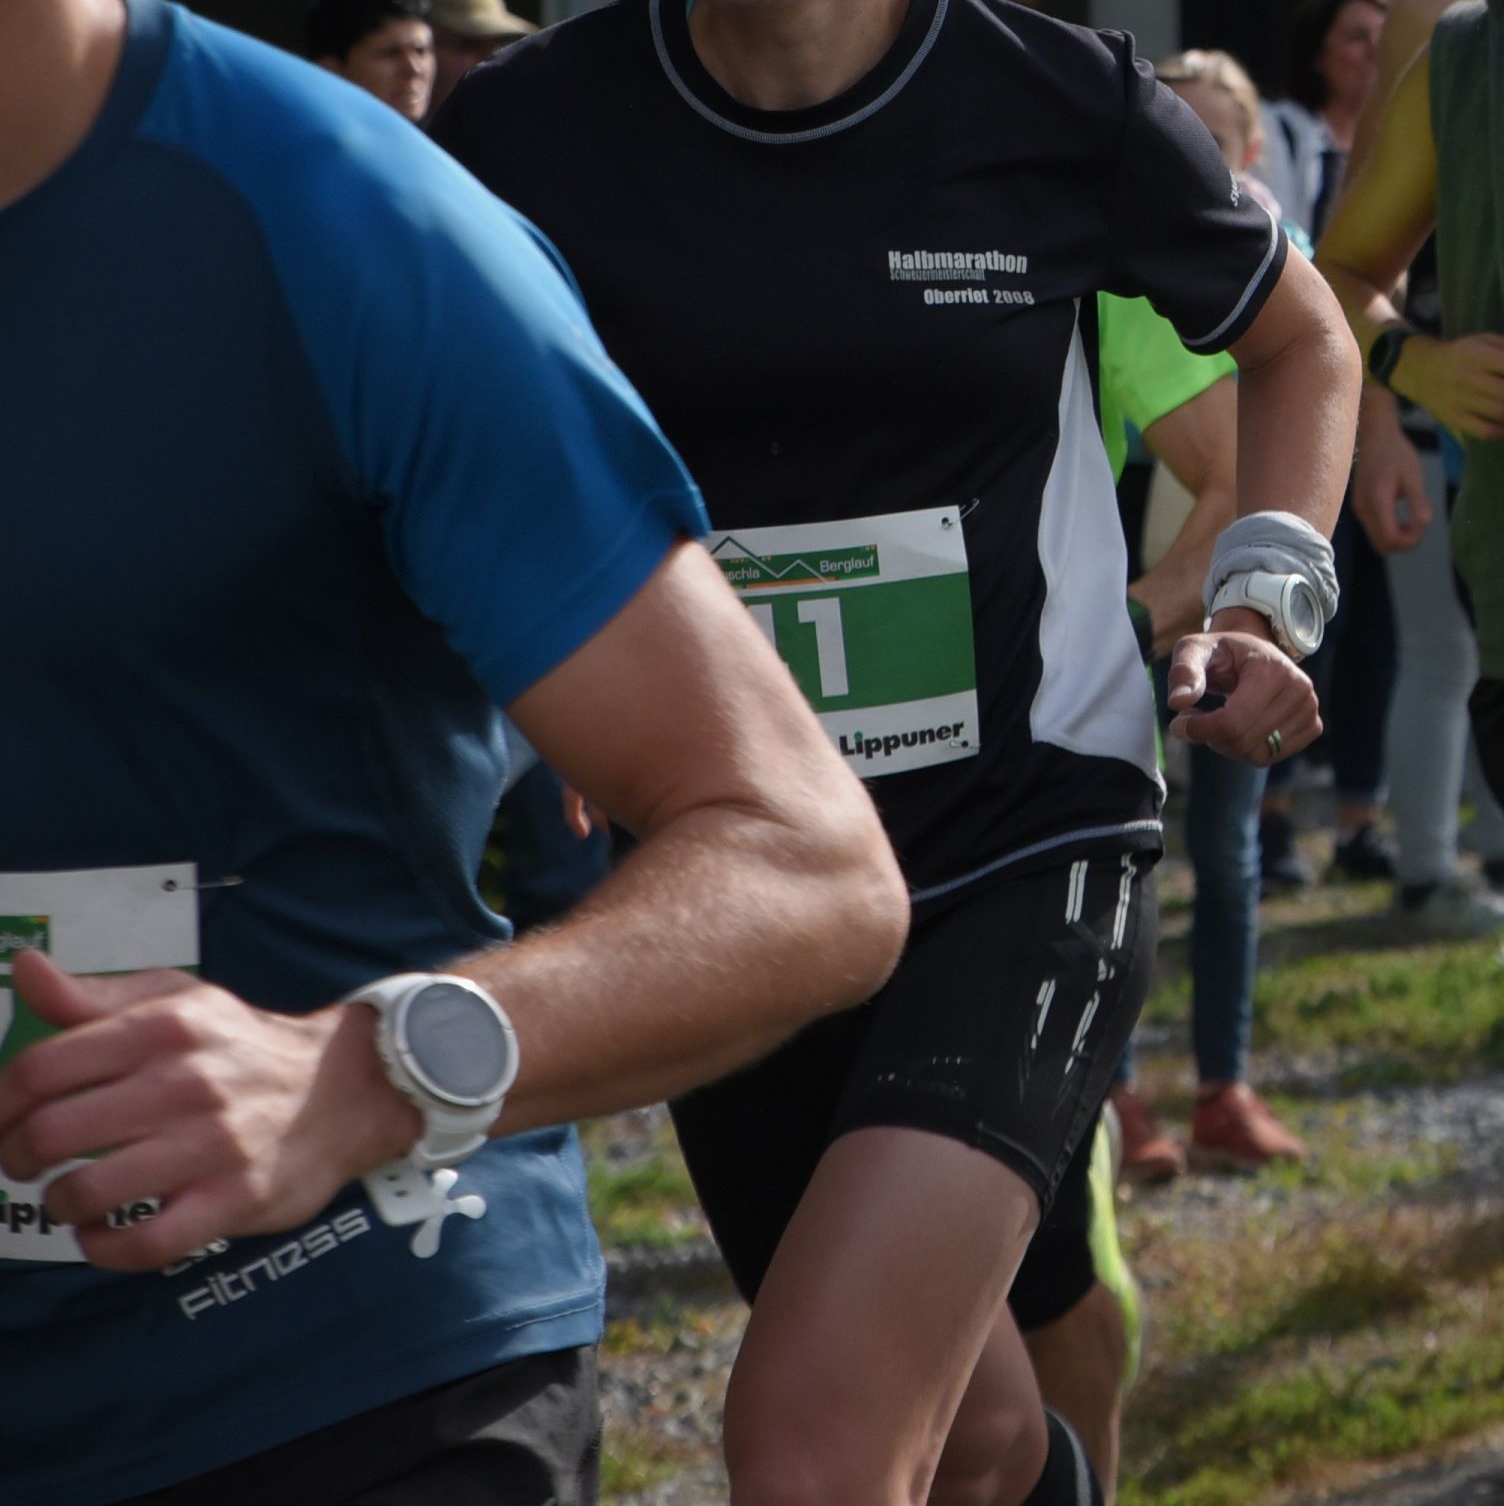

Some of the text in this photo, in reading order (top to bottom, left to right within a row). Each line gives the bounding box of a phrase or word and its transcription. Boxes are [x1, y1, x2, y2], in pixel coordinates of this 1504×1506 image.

[888, 250, 1028, 274] Halbmarathon
[924, 287, 1035, 305] Oberriet 2008
[725, 555, 876, 581] uschla Berglauf
[839, 721, 964, 759] Lippuner
[177, 1207, 372, 1321] Fitness
